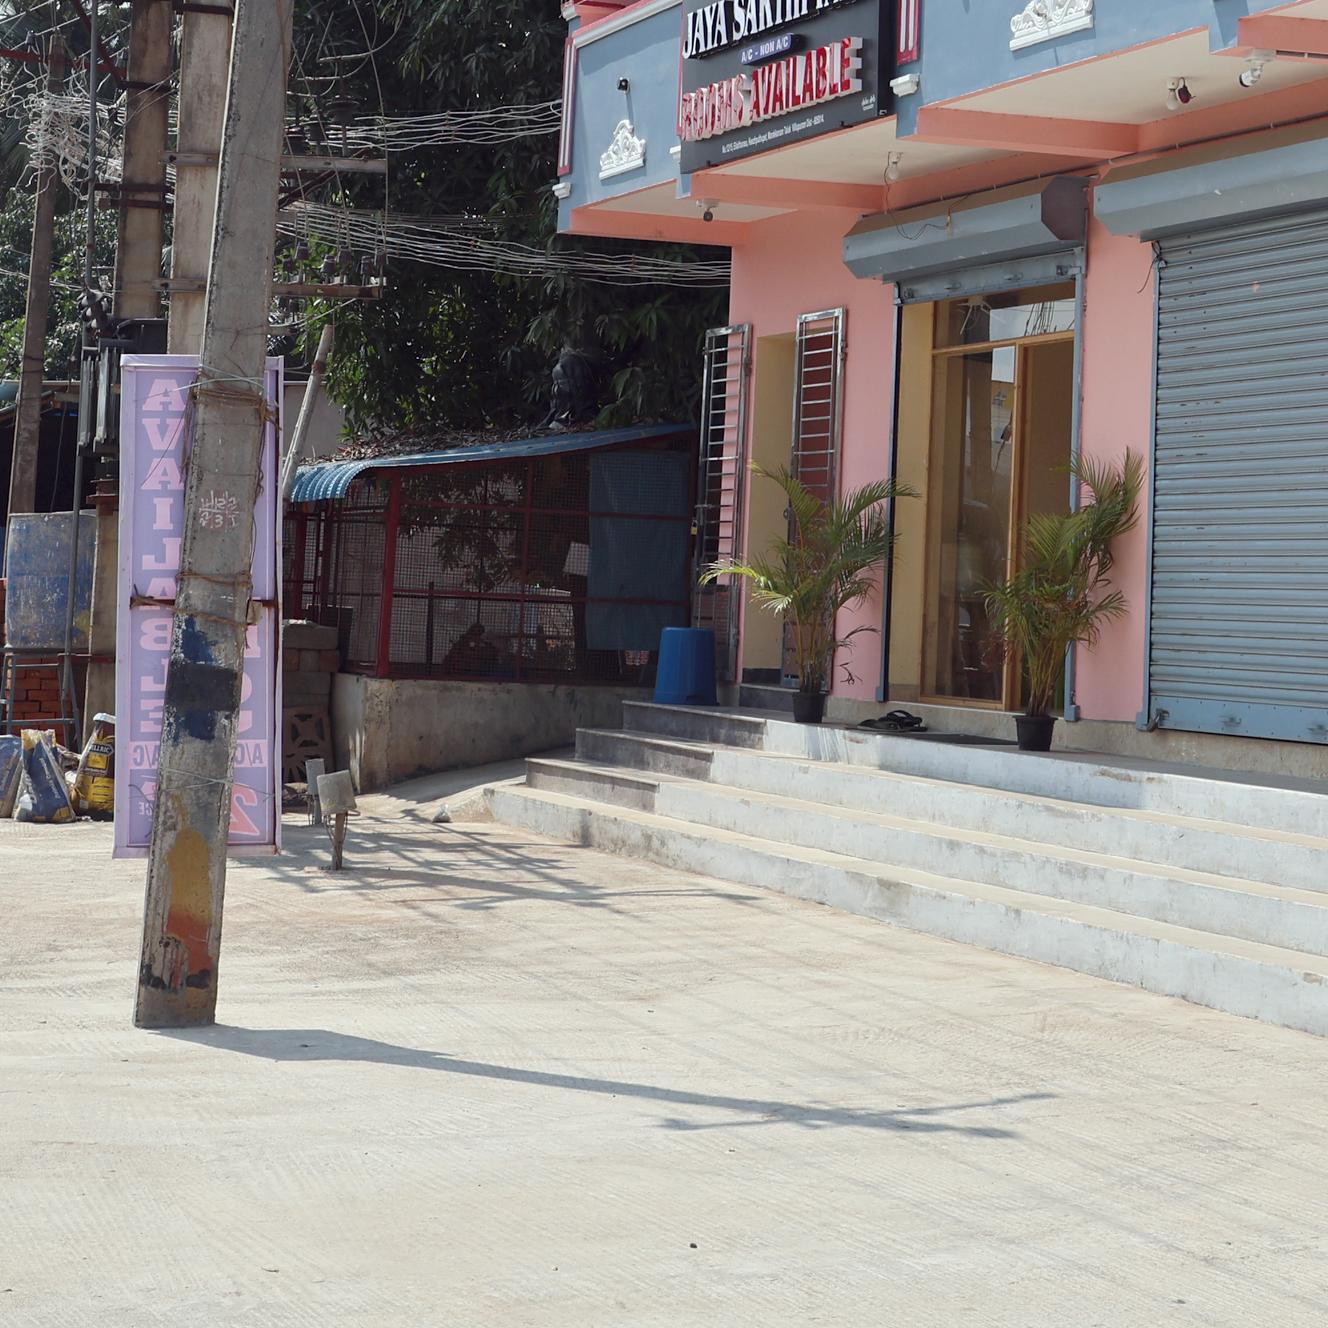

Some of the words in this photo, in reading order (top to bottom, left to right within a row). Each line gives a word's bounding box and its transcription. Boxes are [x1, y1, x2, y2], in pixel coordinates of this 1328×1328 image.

[682, 0, 729, 60] JAYA
[741, 50, 753, 63] A/C
[759, 41, 775, 57] NON
[776, 35, 790, 52] A/C
[682, 73, 746, 141] ROOMS
[749, 37, 856, 122] AVAILABLE
